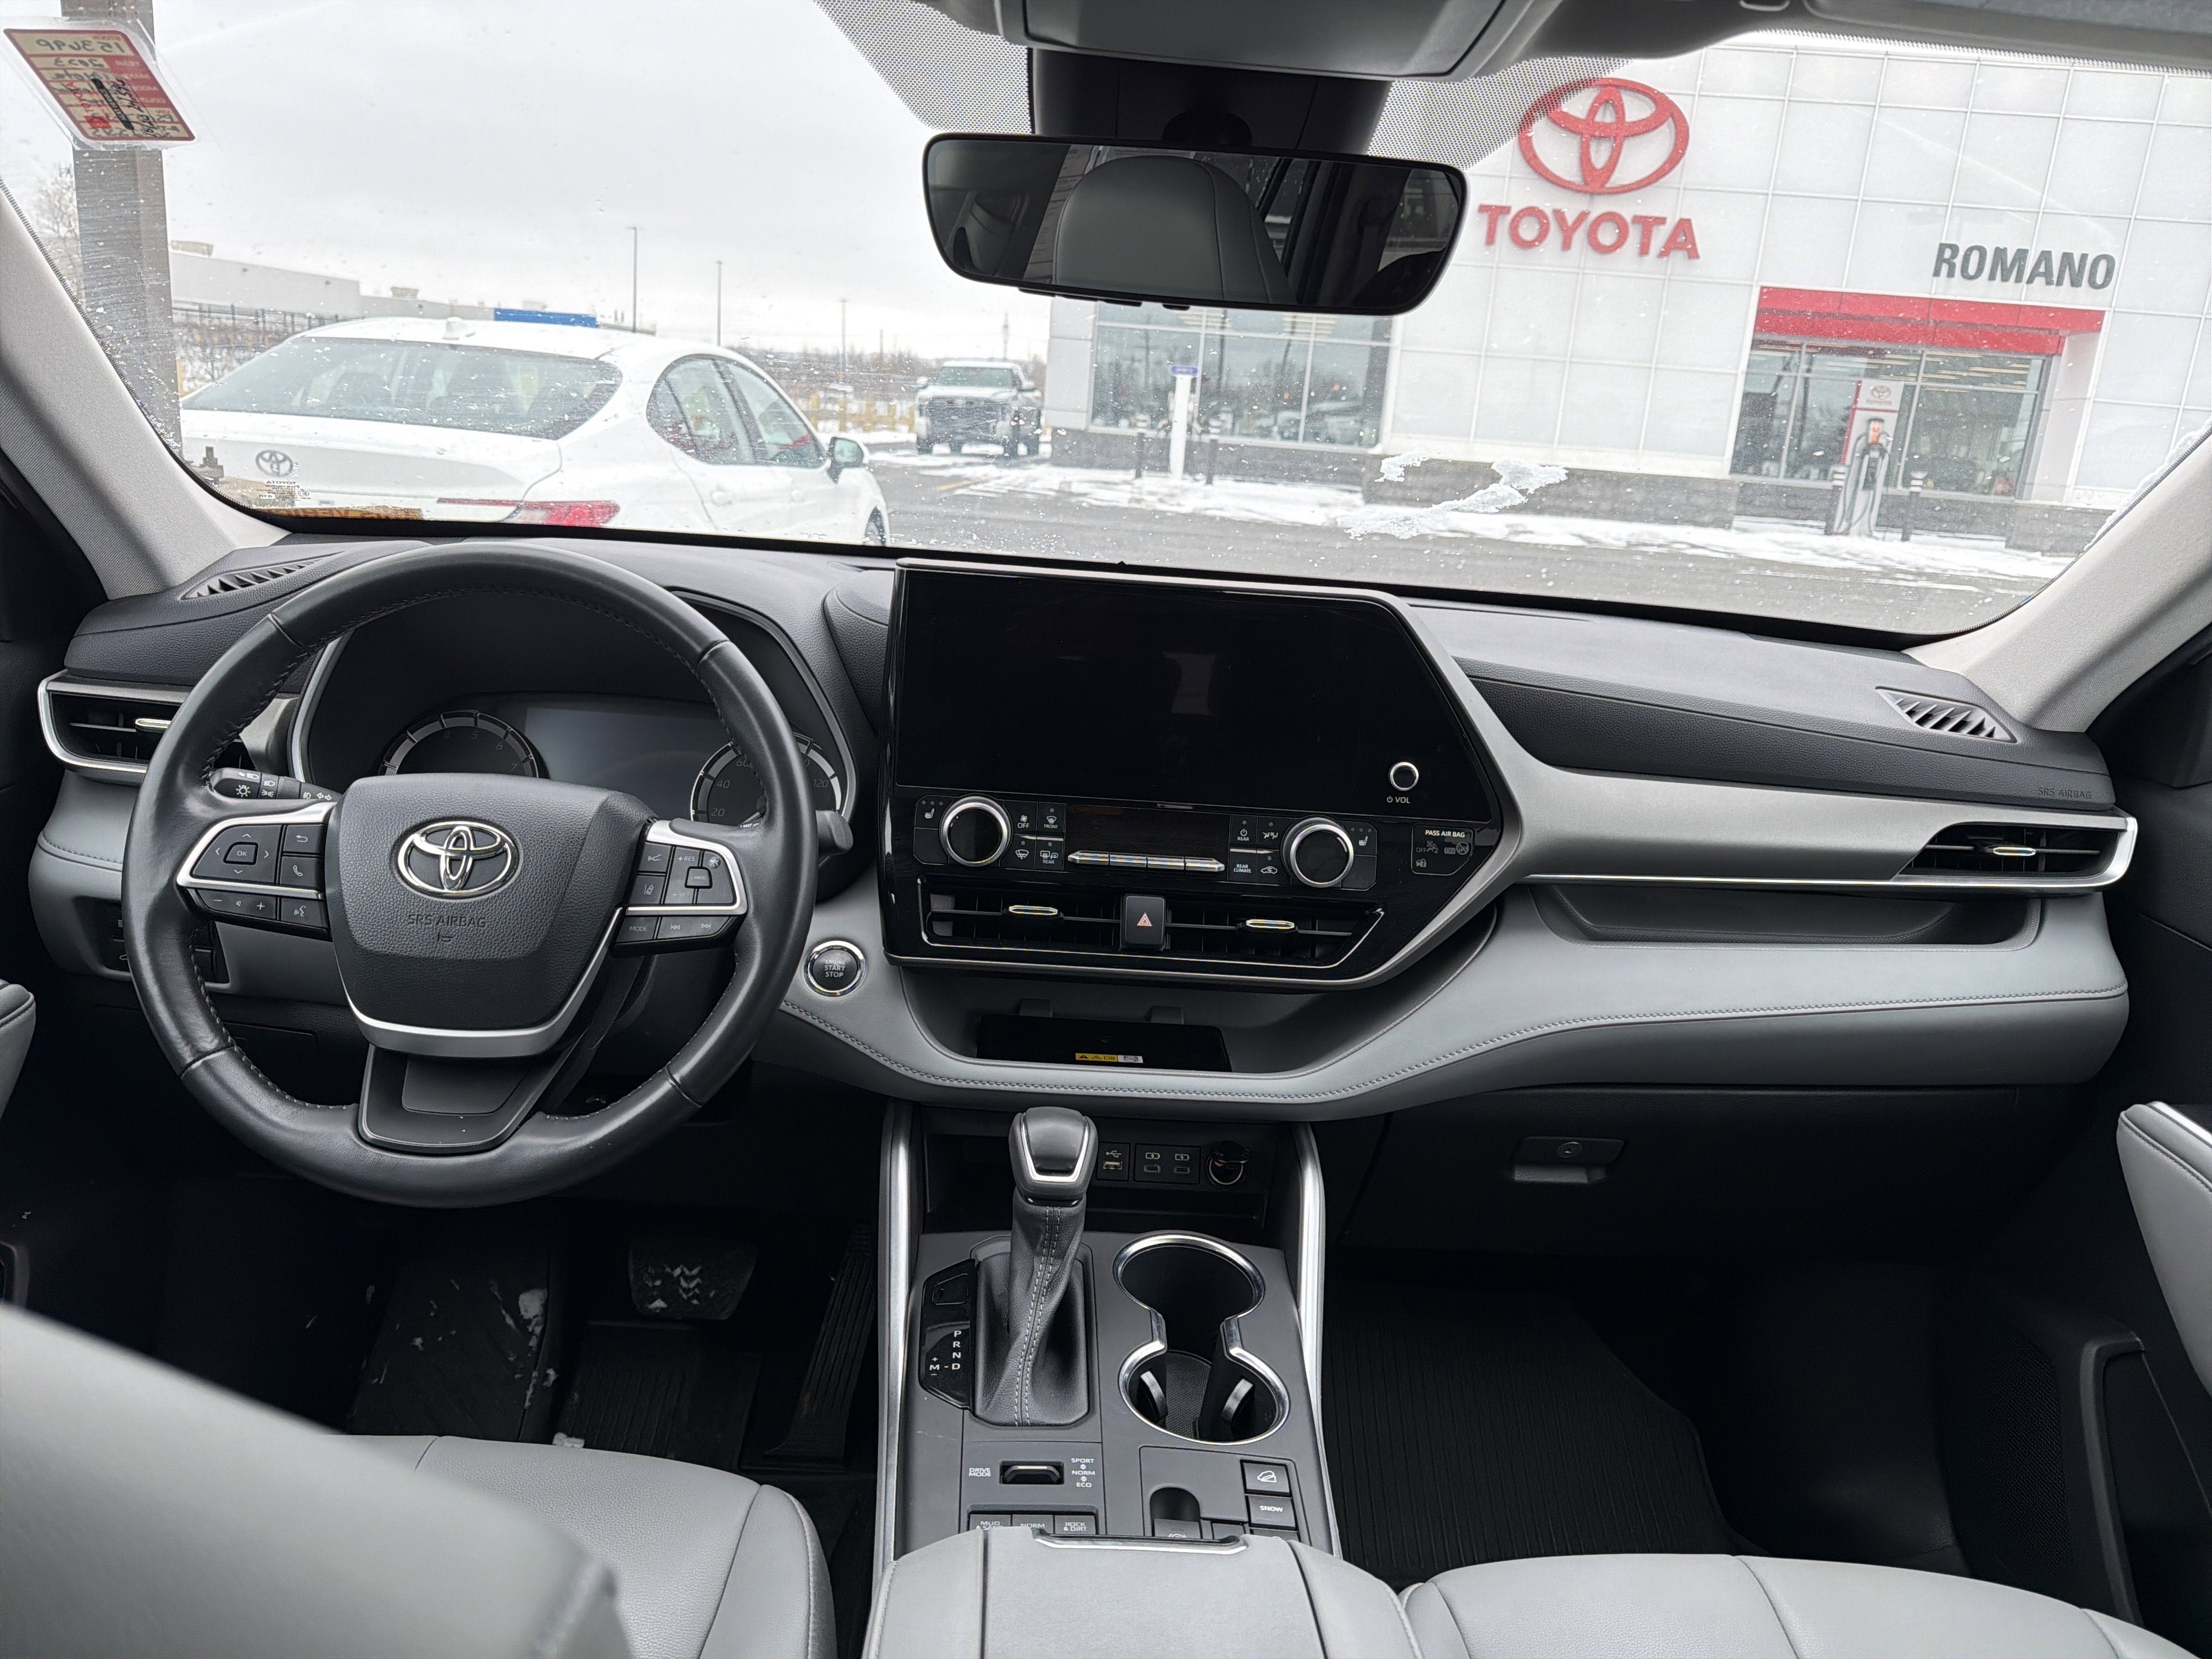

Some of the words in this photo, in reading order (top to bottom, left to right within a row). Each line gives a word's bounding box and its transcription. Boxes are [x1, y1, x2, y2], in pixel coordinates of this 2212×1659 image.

[1477, 204, 1700, 260] TOYOTA
[1933, 242, 2117, 290] ROMANO
[510, 763, 518, 772] 7
[716, 780, 730, 788] 40
[813, 779, 829, 788] 120
[2038, 787, 2055, 795] SRS
[2058, 789, 2092, 799] AIRBAG
[711, 808, 725, 817] 20
[408, 914, 435, 927] SRS
[436, 915, 487, 928] AIRBAG
